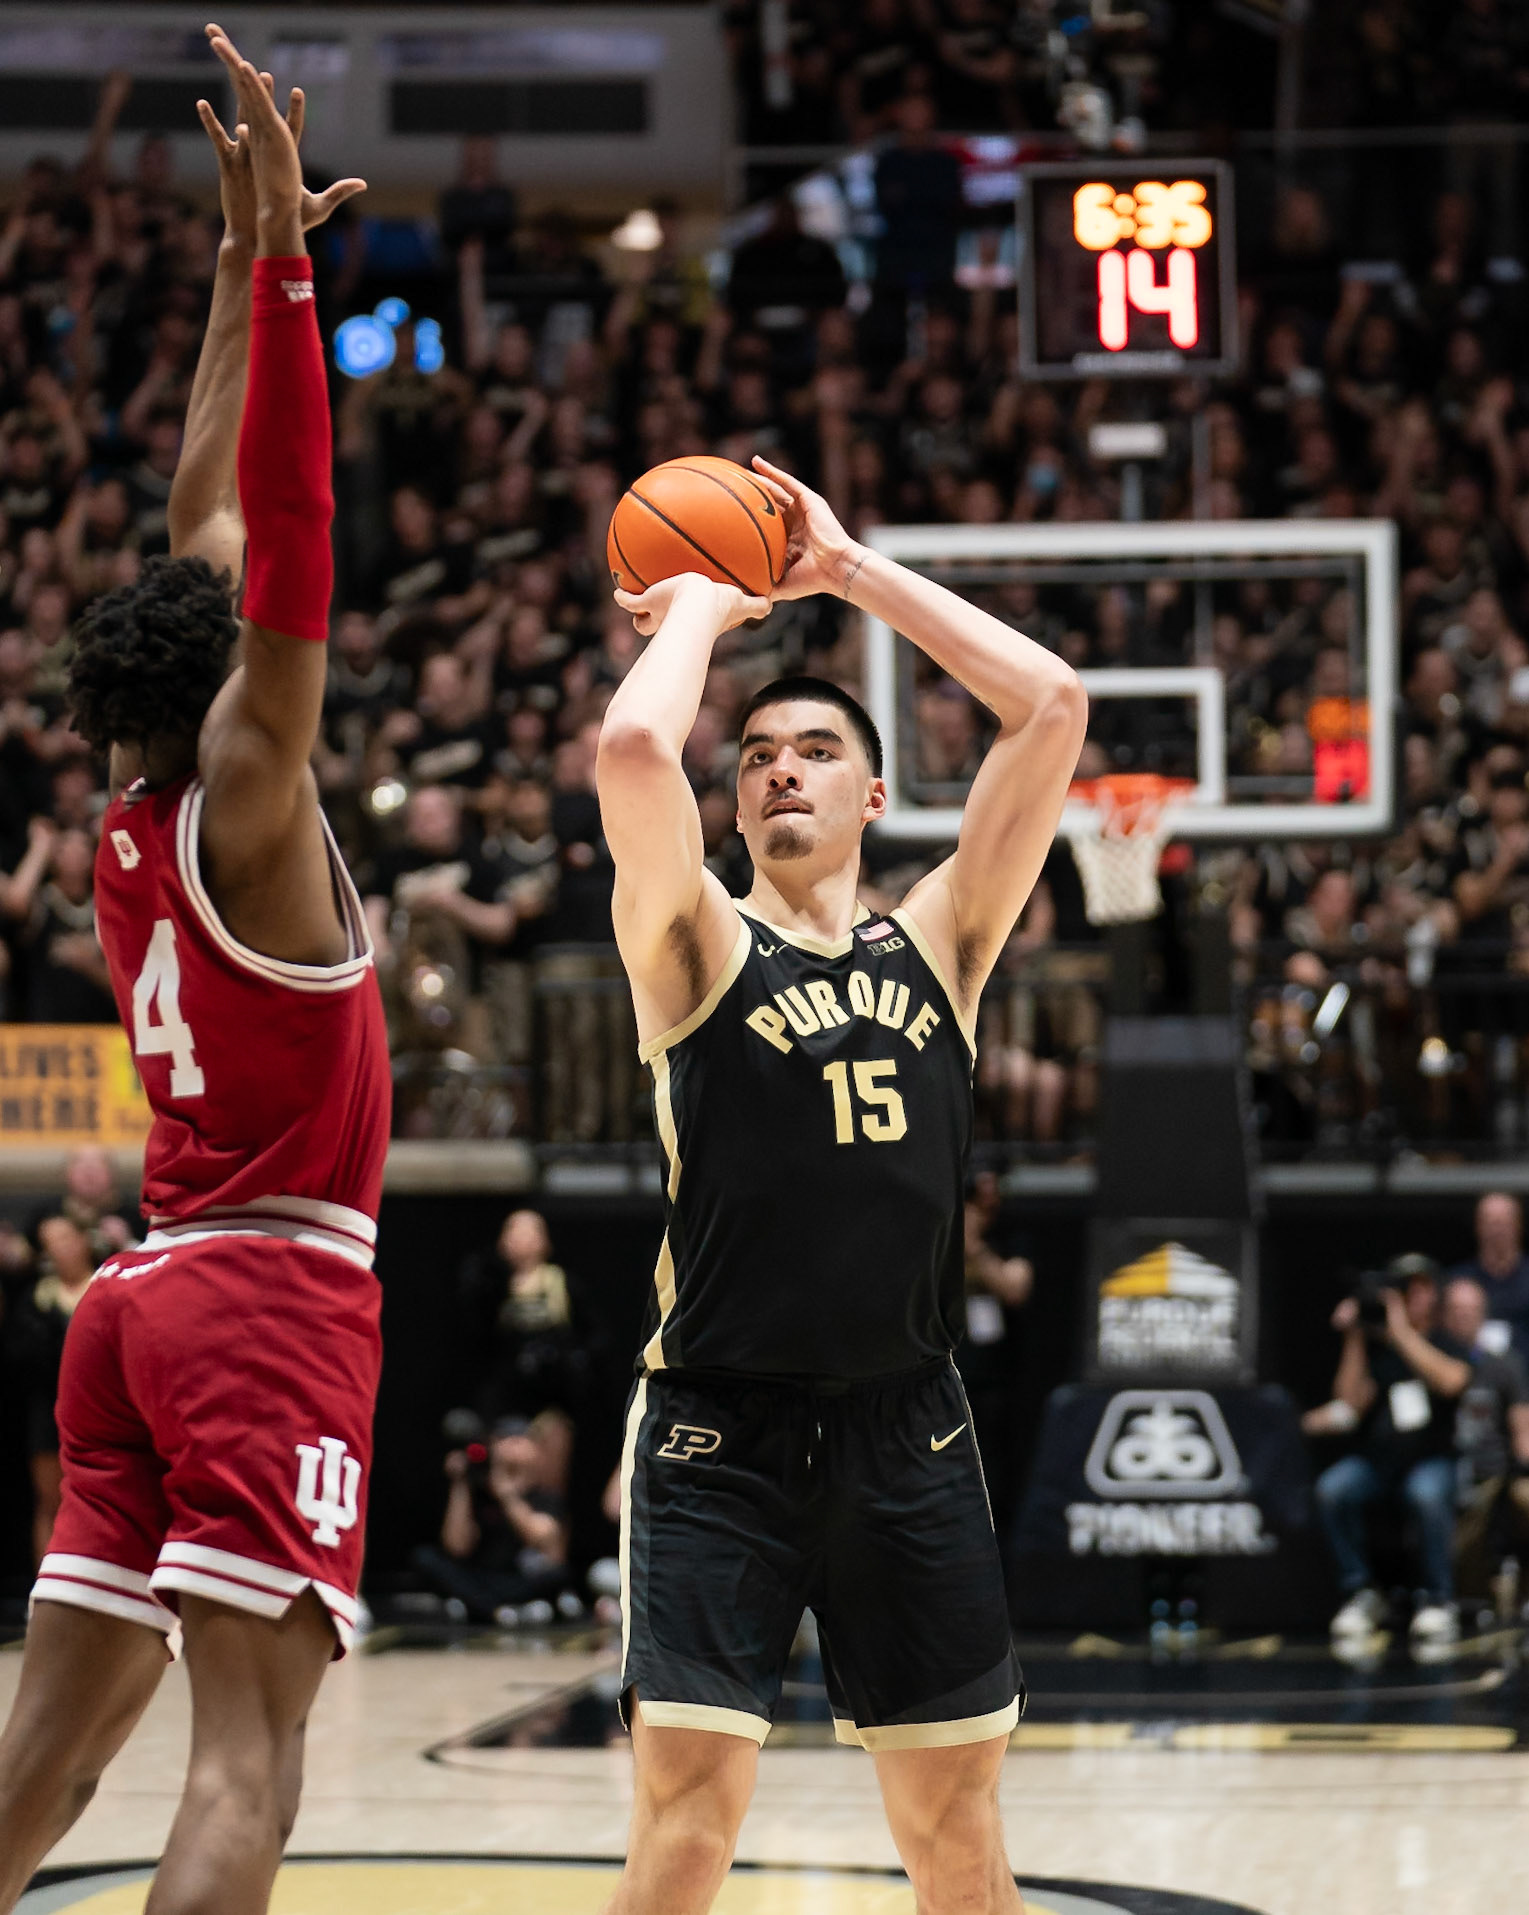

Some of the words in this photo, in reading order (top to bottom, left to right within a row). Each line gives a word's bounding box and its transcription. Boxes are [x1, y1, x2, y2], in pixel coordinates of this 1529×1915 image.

[1073, 180, 1212, 250] 6:35
[1097, 248, 1198, 351] 14
[132, 918, 205, 1098] 4
[745, 970, 941, 1055] PURDUE
[823, 1059, 908, 1143] 15
[656, 1424, 722, 1460] P
